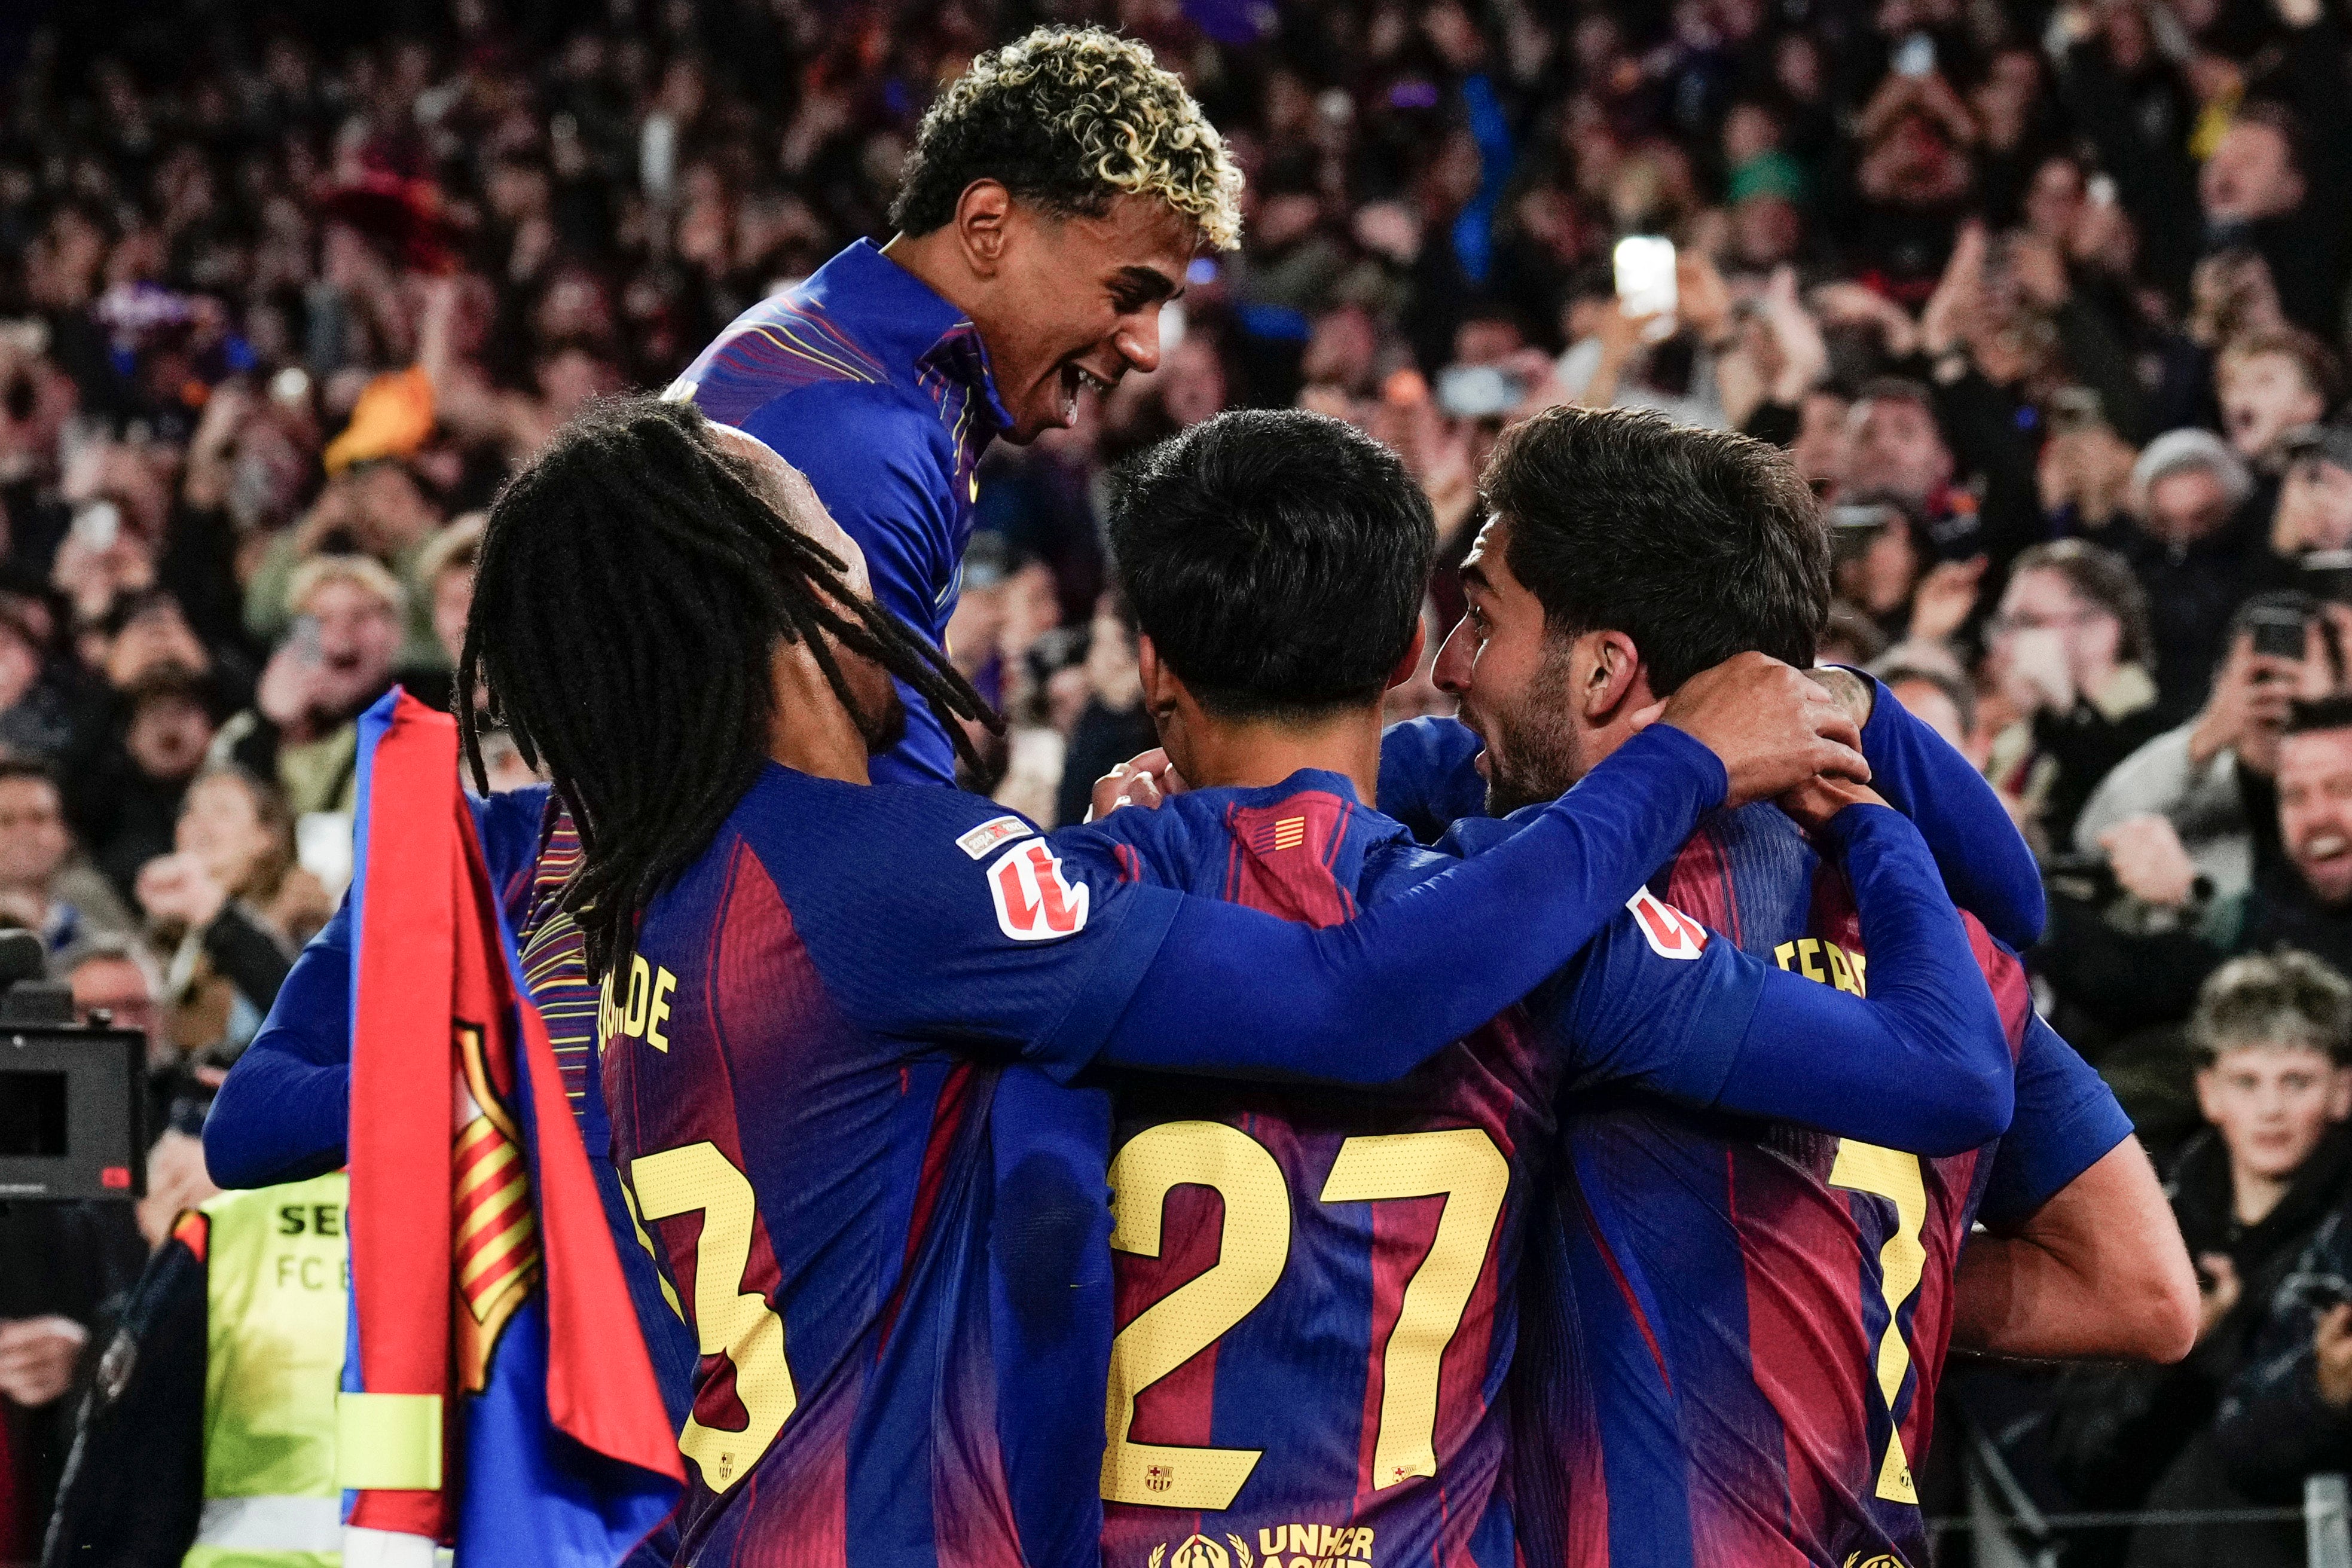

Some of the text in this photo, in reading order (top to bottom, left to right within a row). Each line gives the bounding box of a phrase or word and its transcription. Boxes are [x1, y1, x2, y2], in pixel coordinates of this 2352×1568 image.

[277, 1254, 323, 1291] FC
[630, 1140, 797, 1494] 3
[1099, 1120, 1510, 1511] 27
[1828, 1137, 1926, 1505] 7
[1259, 1523, 1374, 1560] UNHCR
